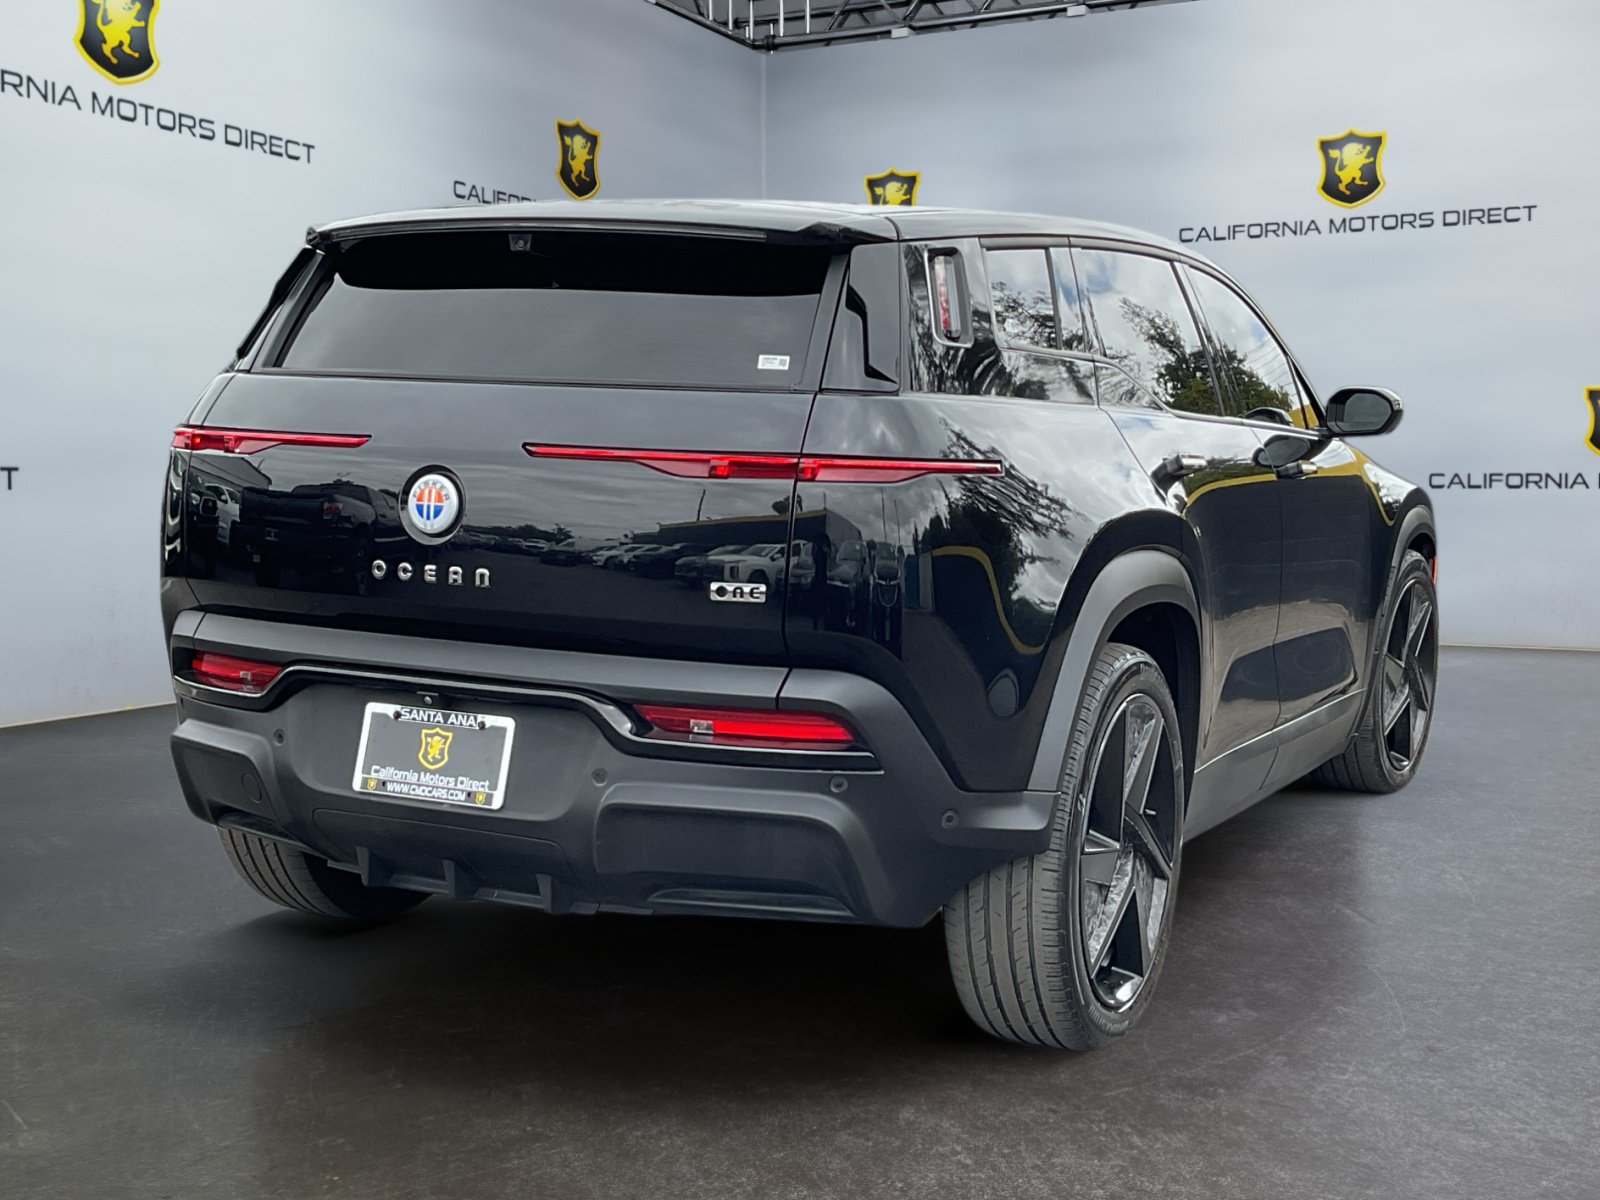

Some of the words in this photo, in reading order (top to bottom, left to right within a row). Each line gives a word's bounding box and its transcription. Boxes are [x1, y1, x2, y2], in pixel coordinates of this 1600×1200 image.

[0, 69, 82, 111] RNIA
[91, 91, 216, 140] MOTORS
[224, 124, 316, 164] DIRECT
[1179, 219, 1322, 243] CALIFORNIA
[1329, 212, 1435, 234] MOTORS
[1442, 205, 1538, 227] DIRECT
[0, 466, 19, 490] T
[1428, 472, 1590, 489] CALIFORNIA
[371, 559, 490, 588] OCEAN
[713, 584, 764, 601] ONE
[400, 708, 444, 724] SANTA
[447, 713, 478, 727] ANA
[371, 765, 418, 781] California
[419, 771, 455, 786] Motors
[457, 776, 490, 791] Direct
[386, 781, 466, 801] WWW.CMDCARS.COM
